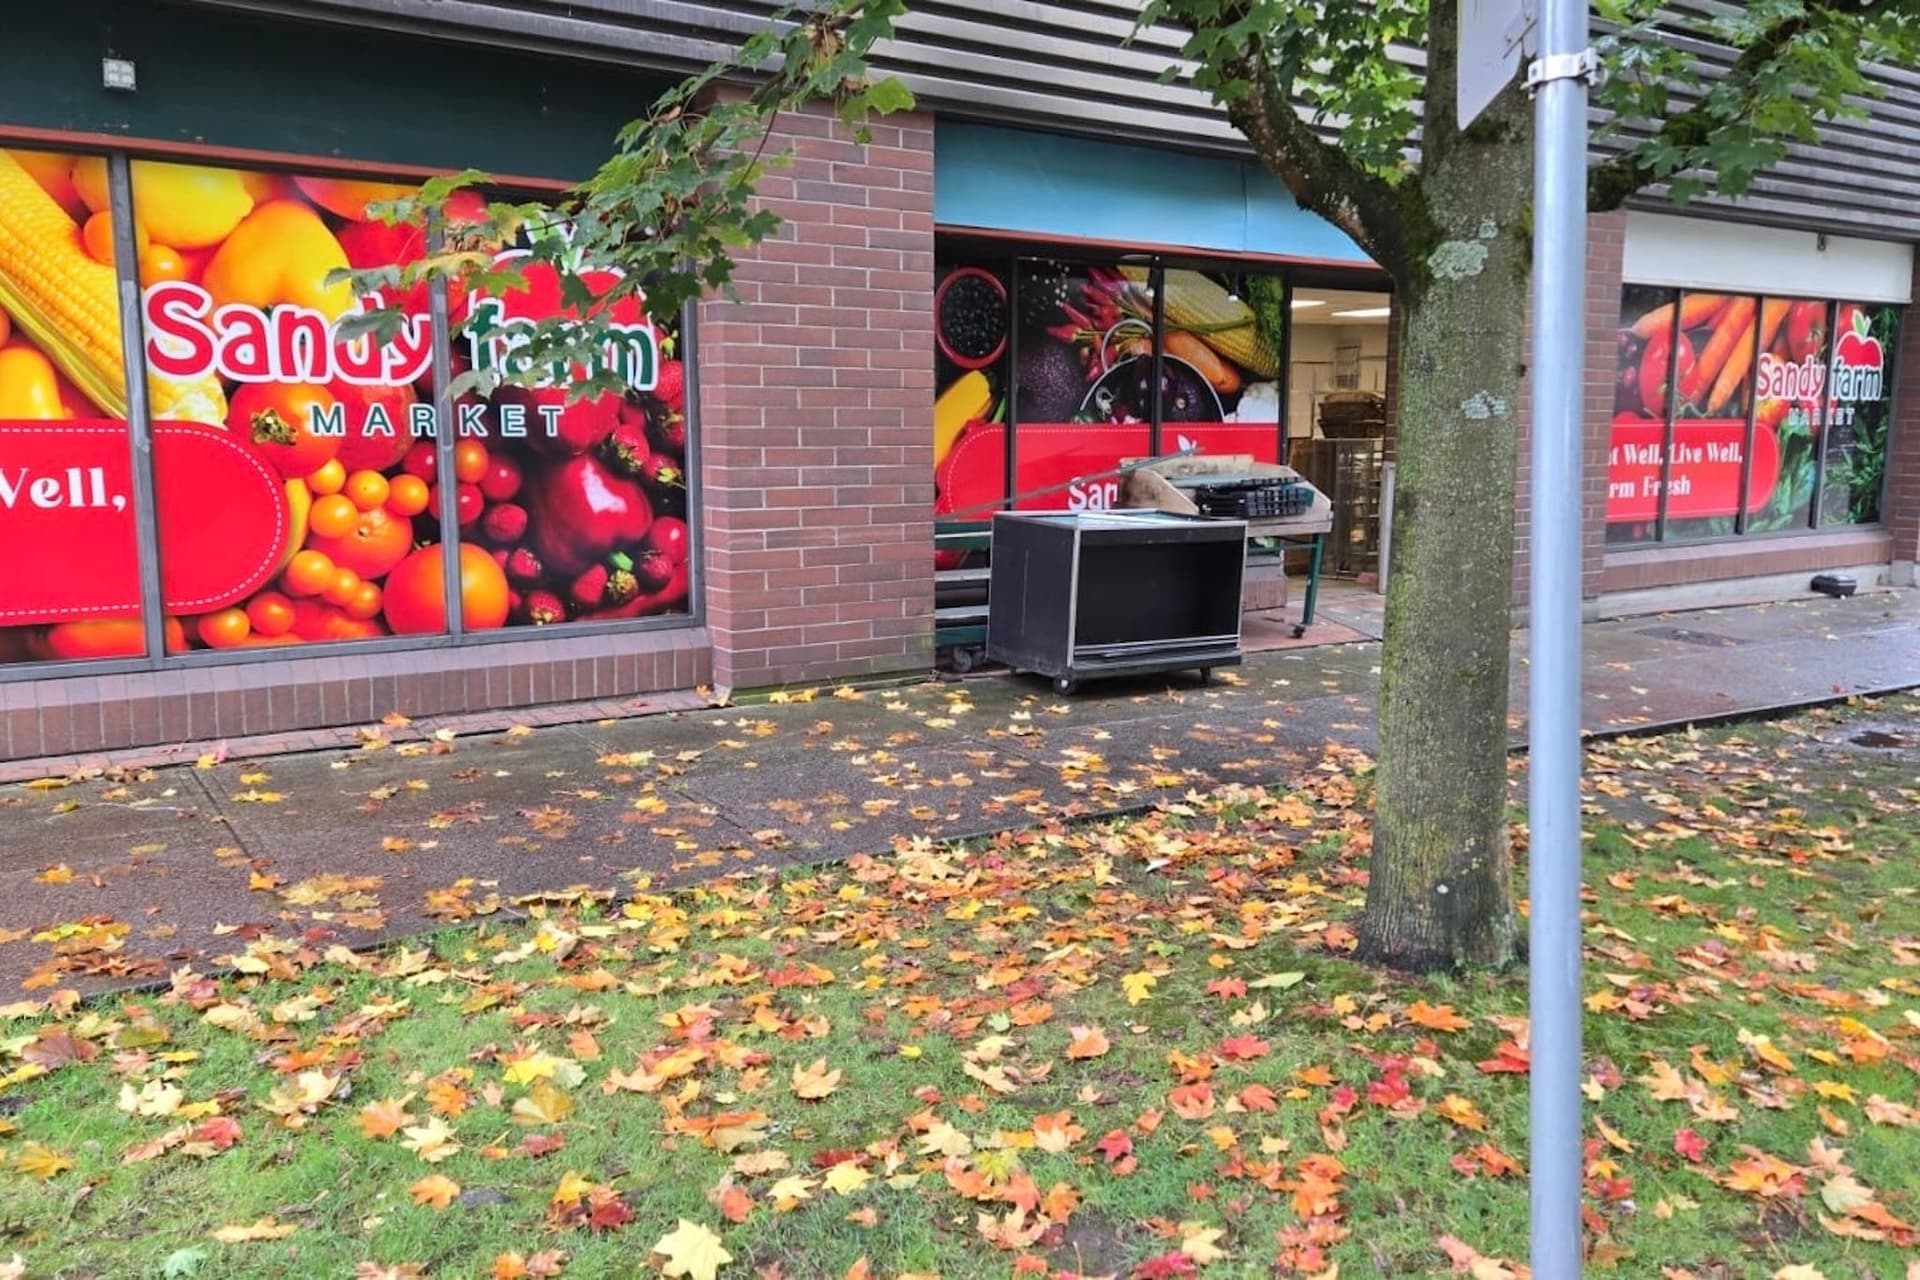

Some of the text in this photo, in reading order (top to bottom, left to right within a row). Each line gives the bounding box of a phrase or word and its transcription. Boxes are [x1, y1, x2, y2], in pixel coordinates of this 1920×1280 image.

[143, 280, 434, 385] Sandy
[1756, 353, 1883, 401] Sandy farm
[311, 401, 565, 438] MARKET
[1668, 442, 1703, 464] Live
[1608, 481, 1636, 499] rm
